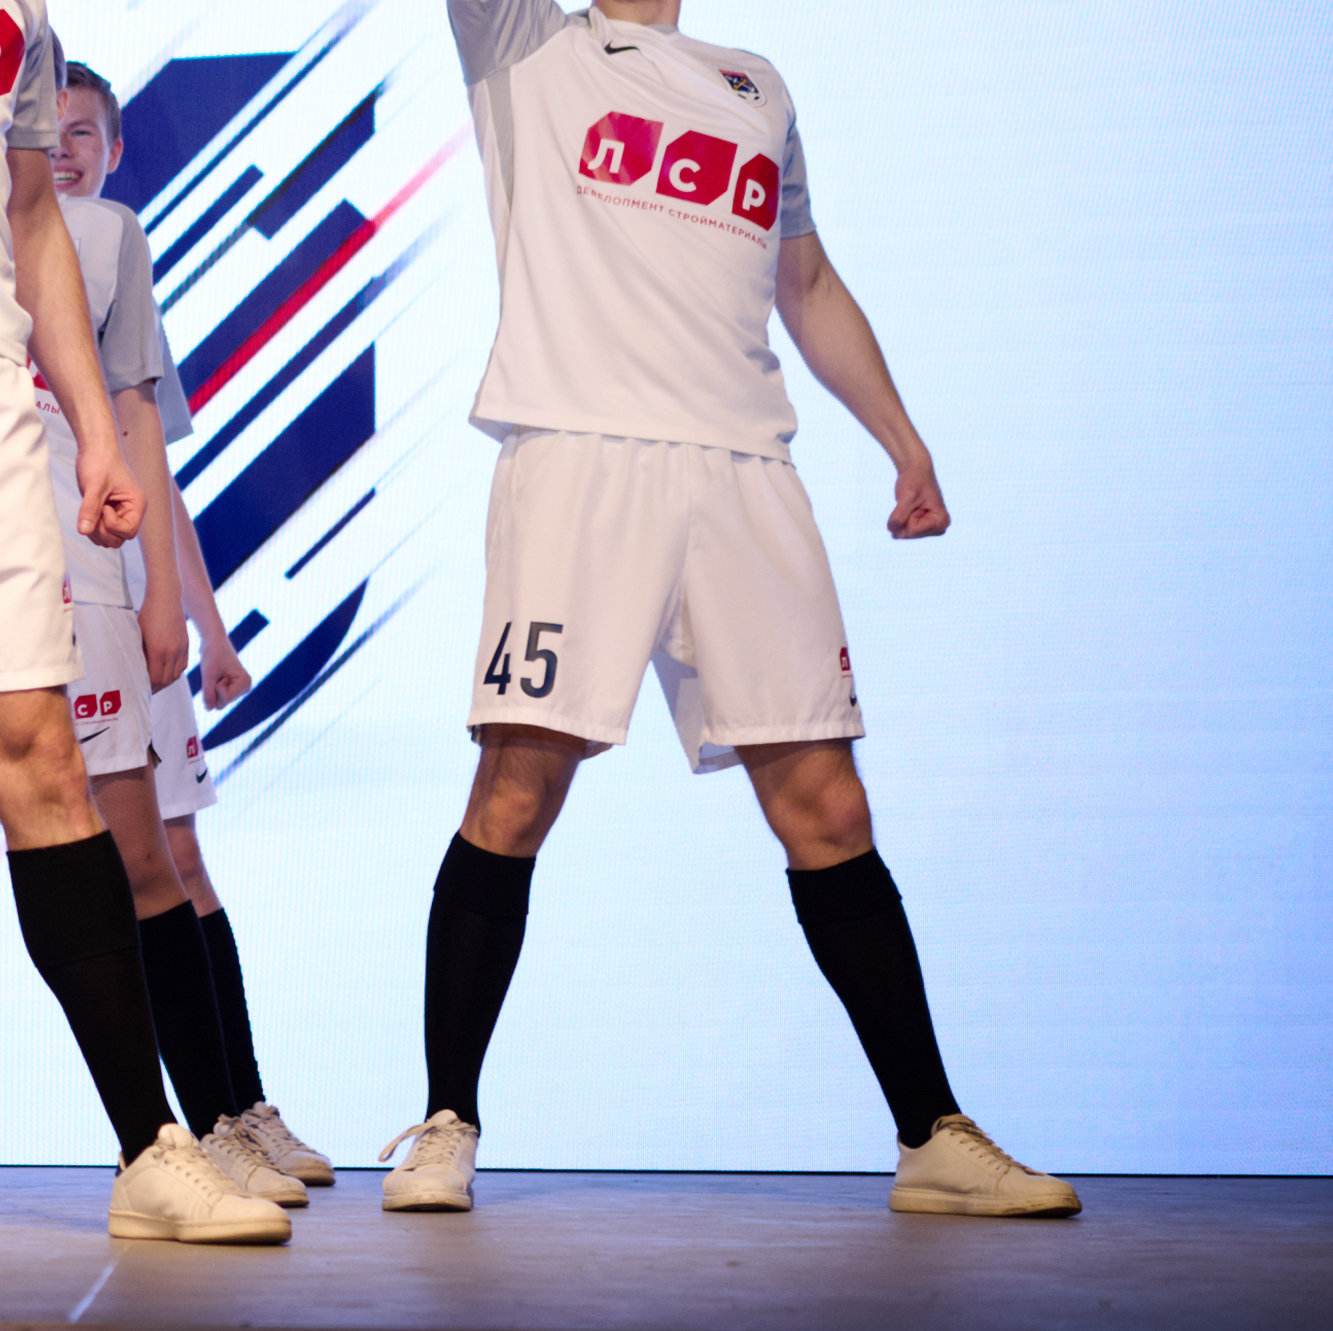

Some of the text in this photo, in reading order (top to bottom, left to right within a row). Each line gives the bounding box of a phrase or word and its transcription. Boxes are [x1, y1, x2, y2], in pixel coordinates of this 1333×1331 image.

[587, 137, 767, 212] ЛСР
[576, 185, 768, 250] ДЕВЕЛОПМЕНТ СТРОЙМАТЕРИАЛЫ
[483, 621, 564, 699] 45
